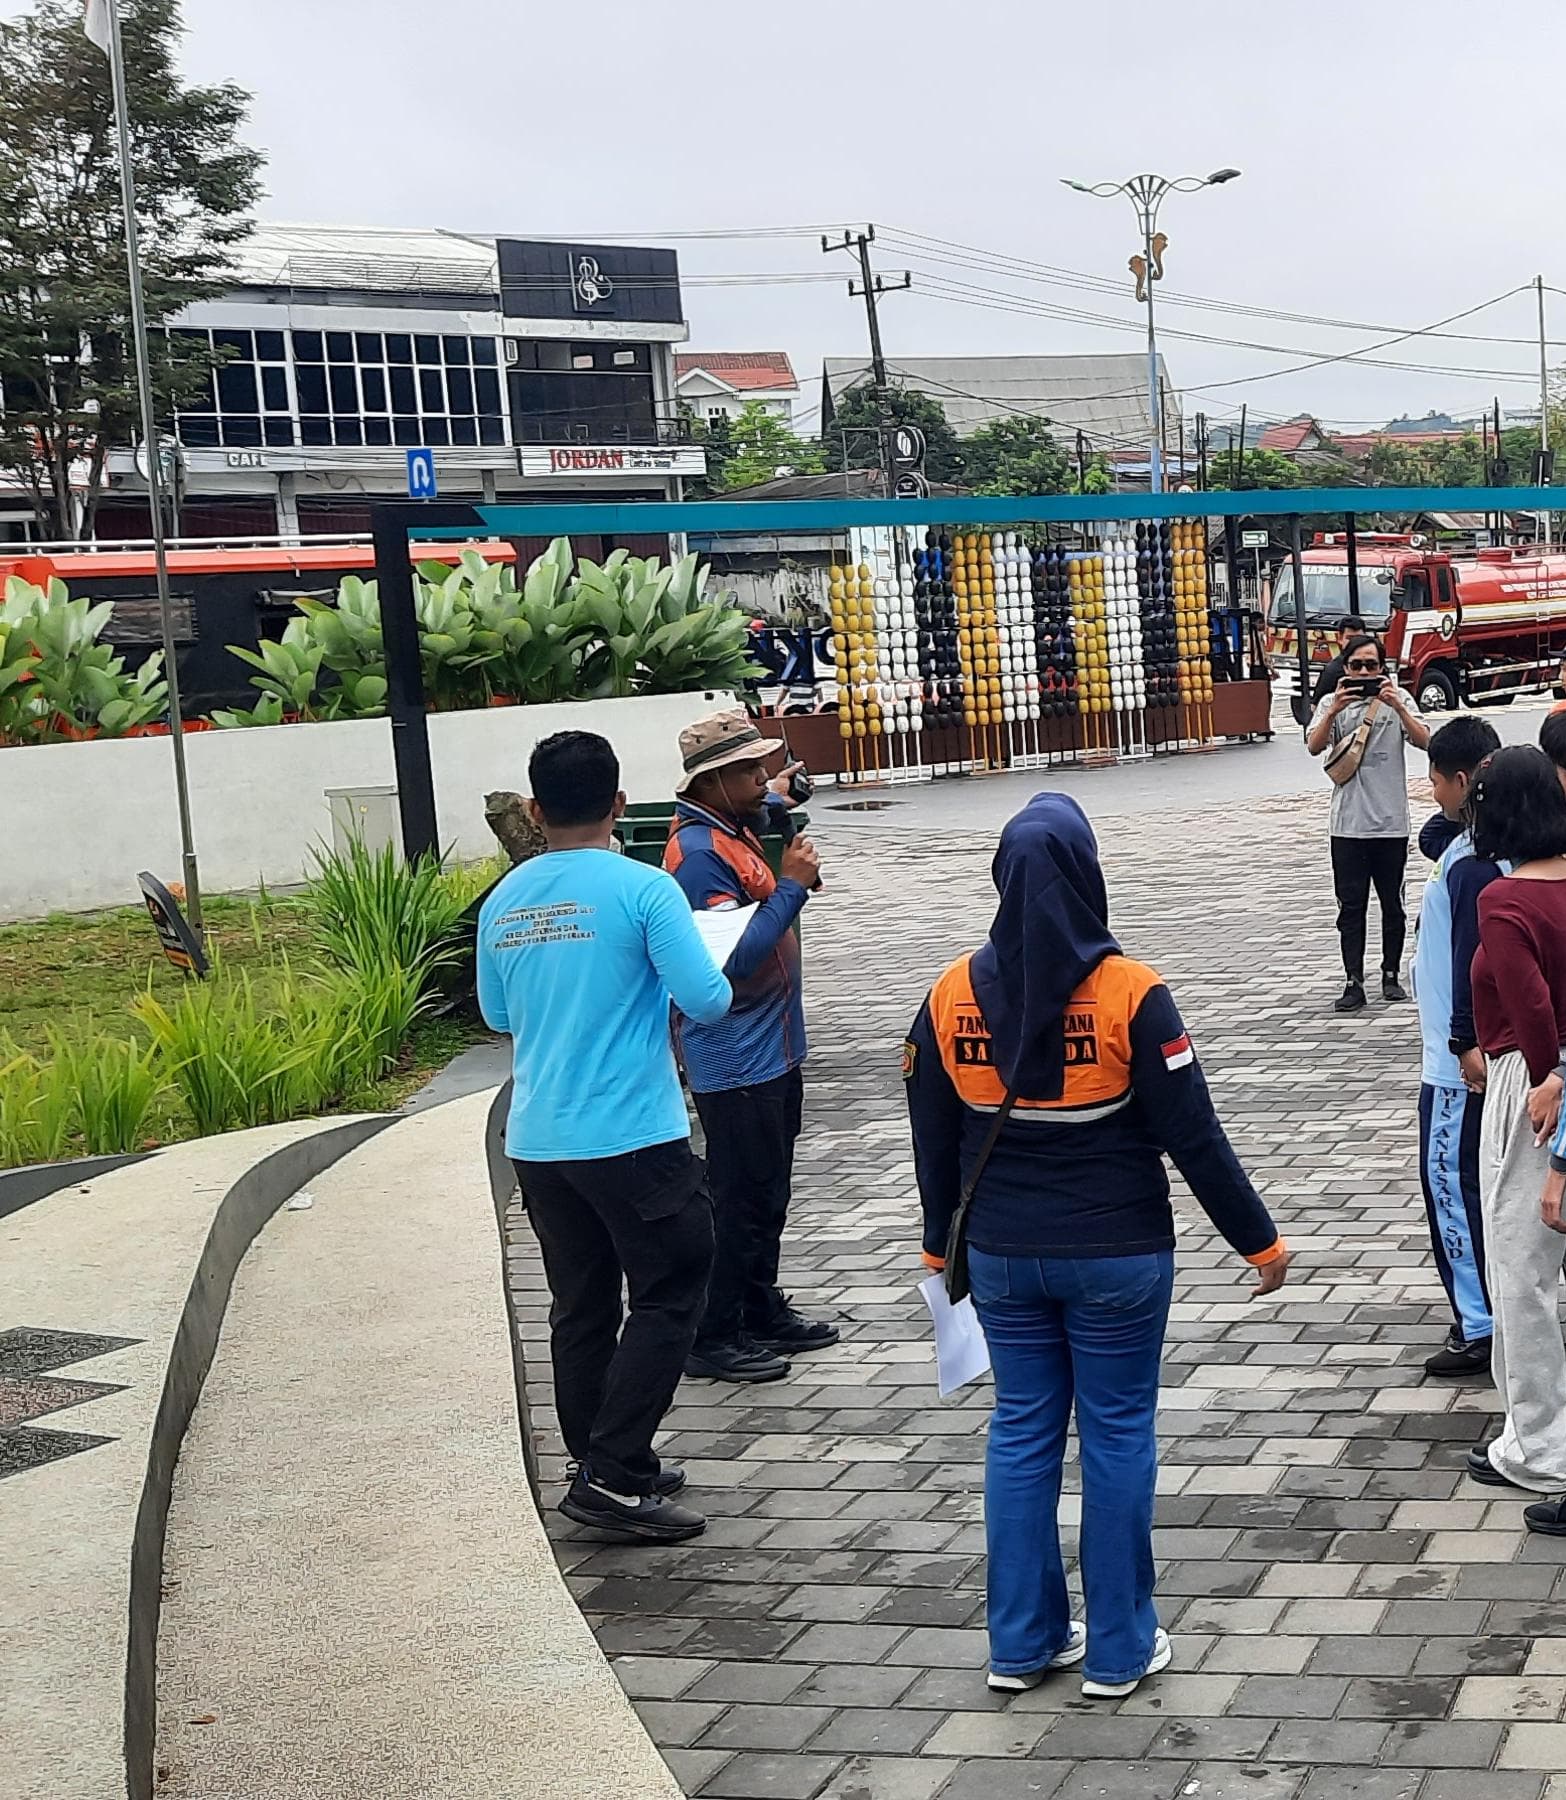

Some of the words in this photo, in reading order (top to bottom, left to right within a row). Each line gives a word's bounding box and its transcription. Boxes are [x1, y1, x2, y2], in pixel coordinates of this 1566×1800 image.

[228, 452, 268, 467] CAFE
[550, 449, 624, 473] JORDAN
[1433, 1127, 1453, 1219] ANTASARI
[1444, 1225, 1463, 1259] SMD
